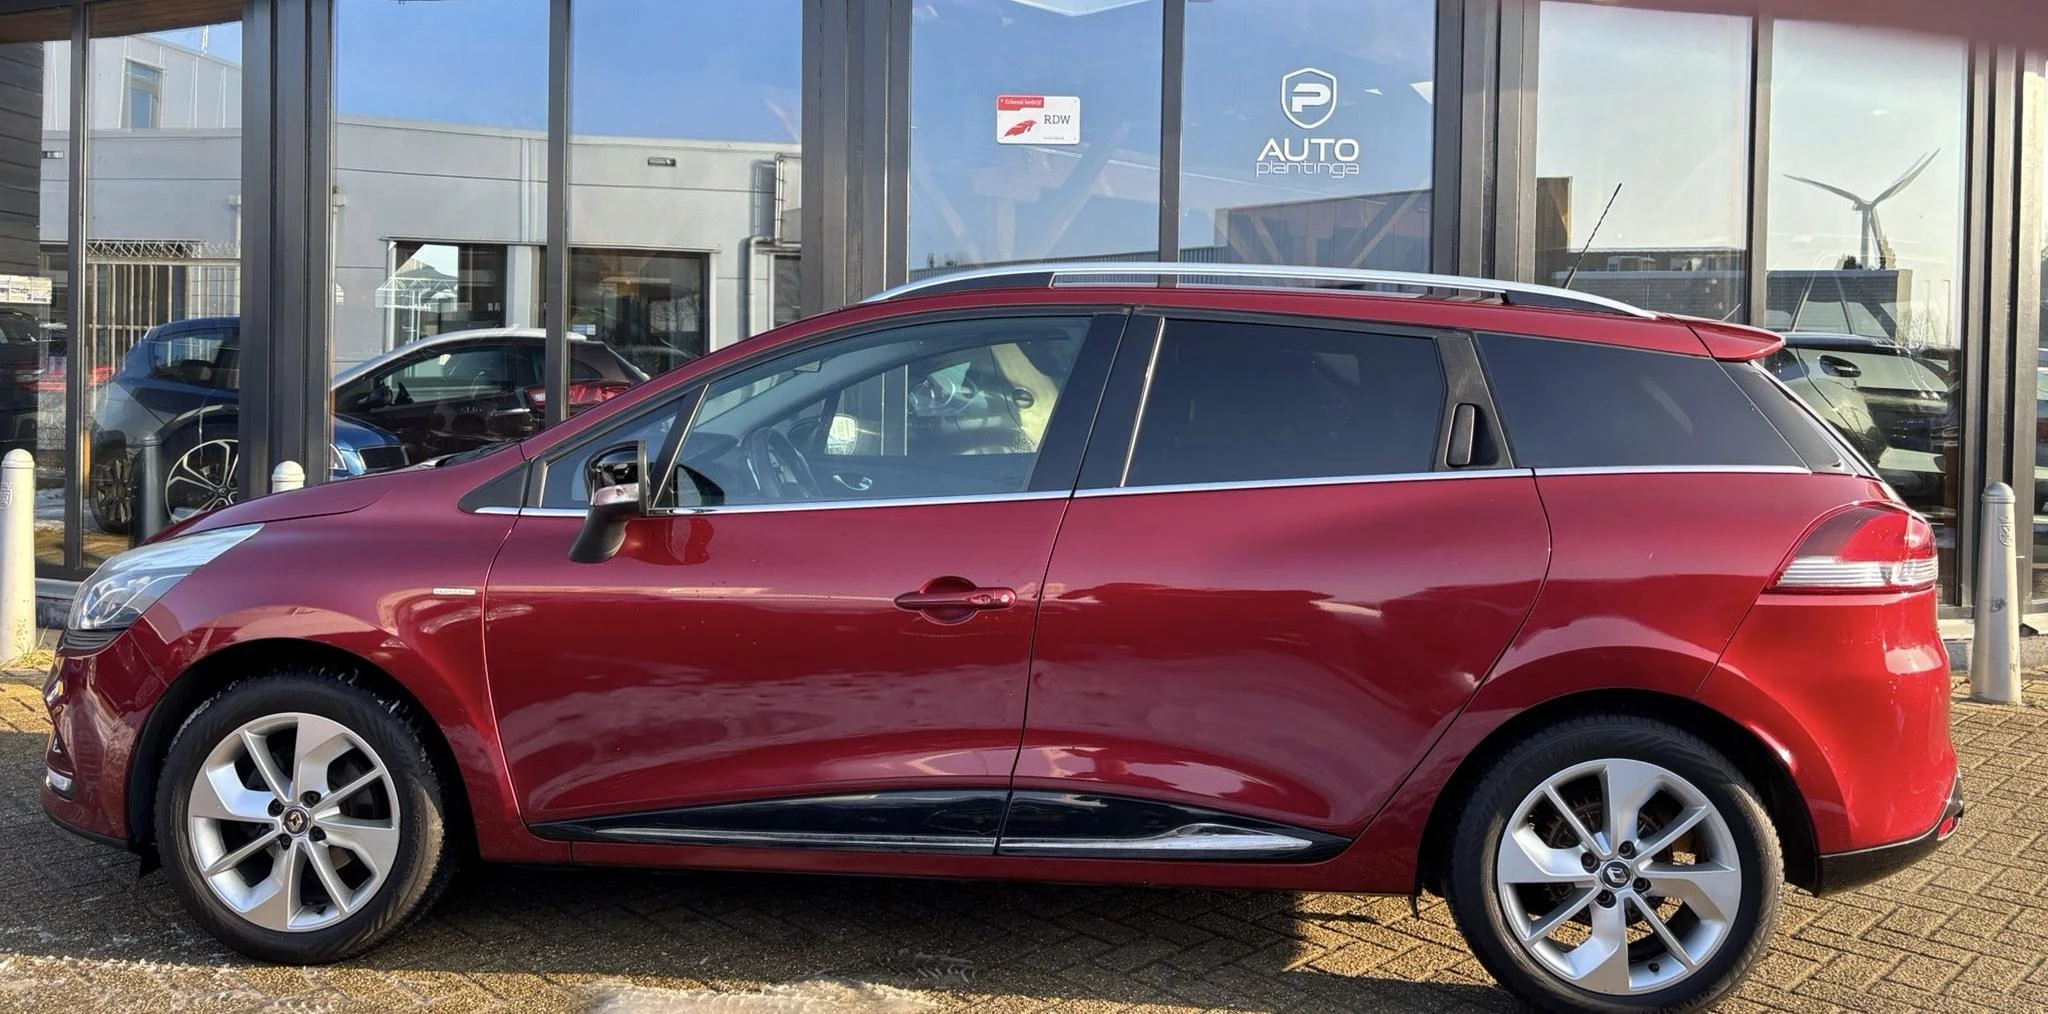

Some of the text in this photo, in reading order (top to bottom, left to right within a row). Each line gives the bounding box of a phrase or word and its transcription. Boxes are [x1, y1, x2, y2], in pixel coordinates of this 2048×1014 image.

[1043, 114, 1071, 125] RDW
[1257, 138, 1359, 161] AUTO
[1256, 160, 1359, 179] plantinga
